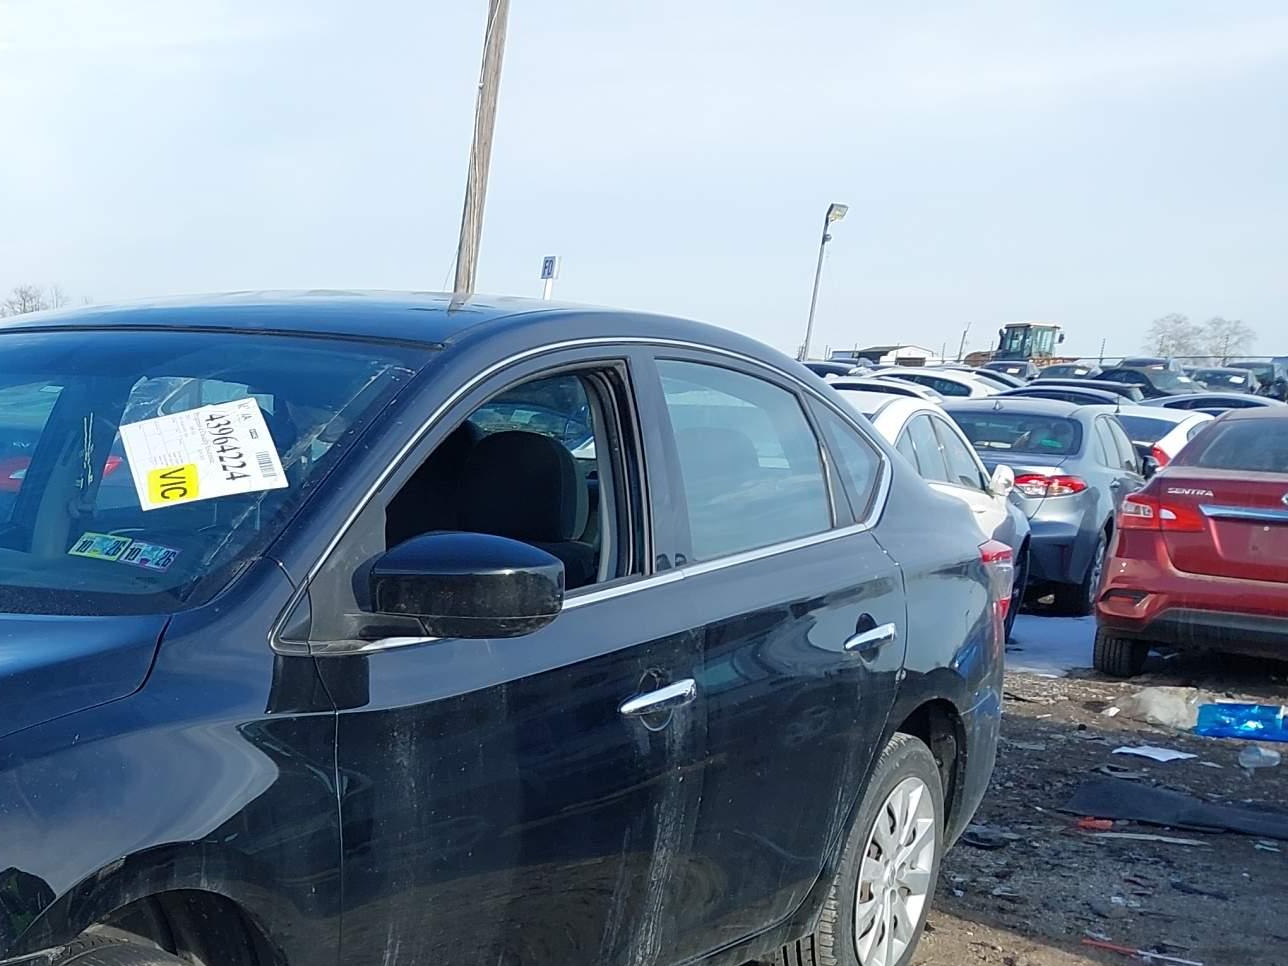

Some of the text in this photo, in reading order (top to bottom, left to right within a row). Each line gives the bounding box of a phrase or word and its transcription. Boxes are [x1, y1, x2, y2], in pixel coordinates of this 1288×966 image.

[205, 414, 252, 481] 43964224
[159, 467, 188, 499] VIC
[1167, 487, 1214, 497] SENTRA
[76, 539, 126, 556] 10 26
[155, 550, 177, 567] 26
